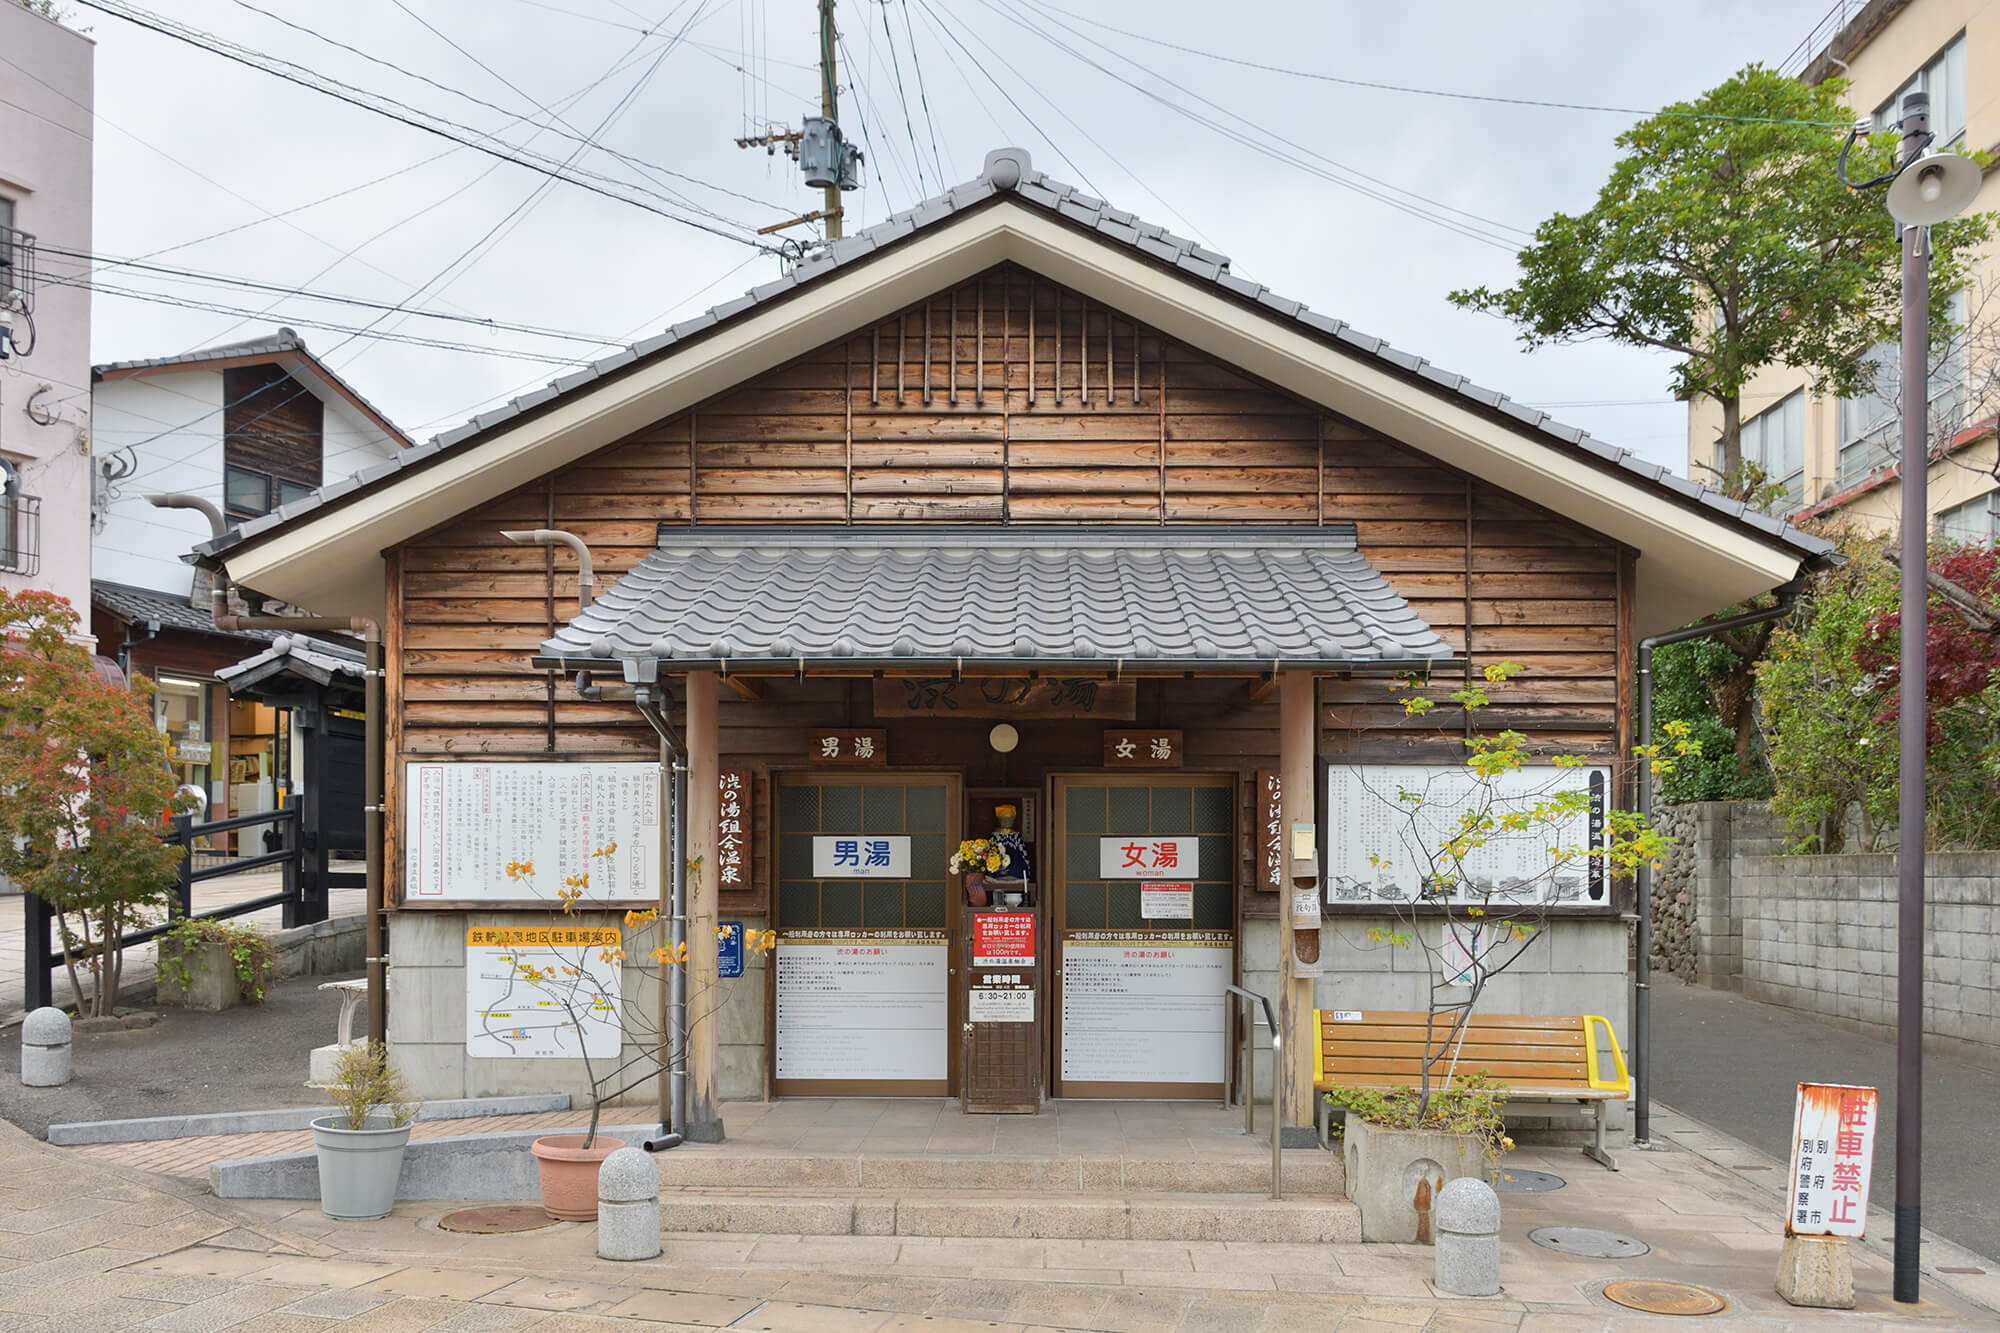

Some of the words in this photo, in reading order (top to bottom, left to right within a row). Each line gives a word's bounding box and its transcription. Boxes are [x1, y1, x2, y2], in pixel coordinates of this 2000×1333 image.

[820, 737, 874, 759] 男湯
[1115, 738, 1173, 760] 女湯
[833, 841, 891, 867] 男湯
[1120, 842, 1178, 868] 女湯
[1829, 1097, 1868, 1224] 駐車禁止
[1797, 1138, 1814, 1224] 別府警察署
[1810, 1138, 1828, 1225] 別府市
